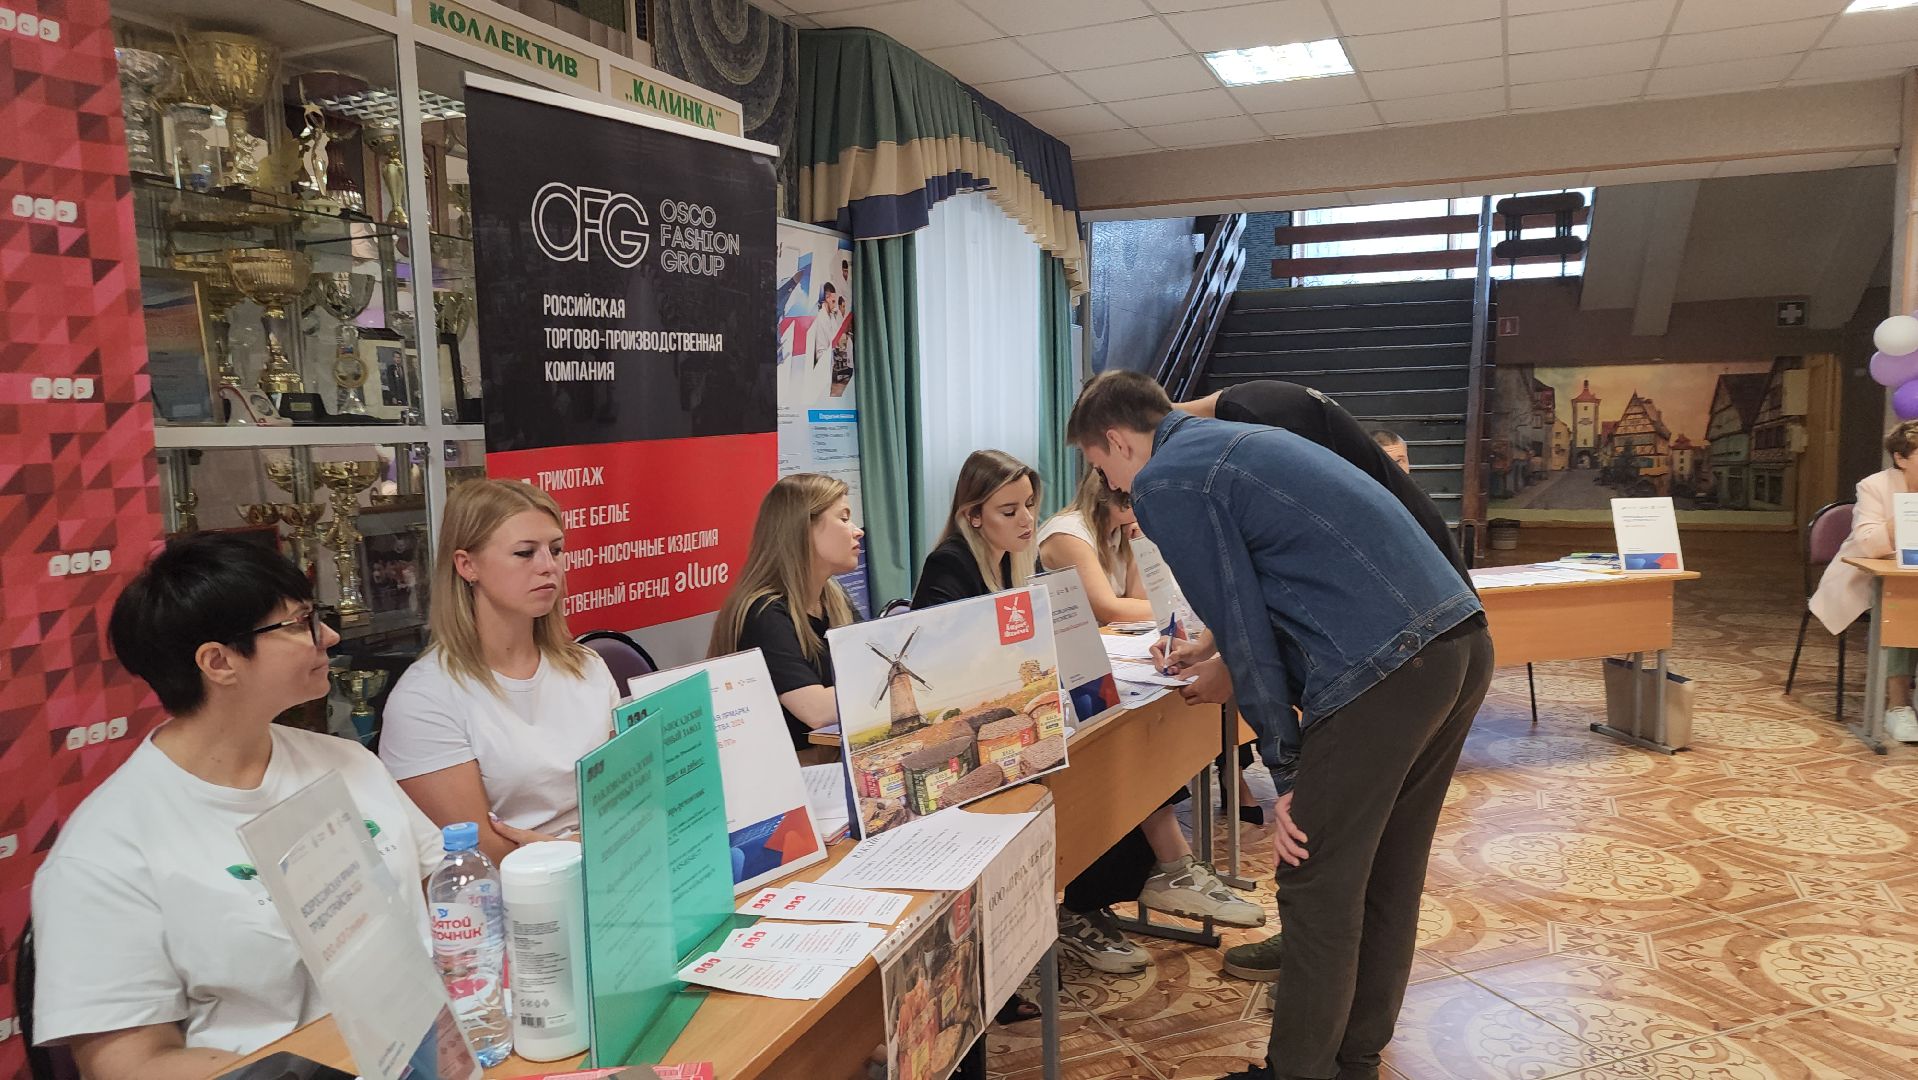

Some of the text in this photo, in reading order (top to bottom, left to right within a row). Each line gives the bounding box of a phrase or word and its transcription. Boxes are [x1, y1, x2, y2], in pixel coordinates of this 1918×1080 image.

[429, 1, 579, 79] КОЛЛЕКТИВ
[531, 182, 650, 269] OFG
[659, 199, 717, 228] OSCO
[660, 224, 740, 256] FASHION
[660, 249, 725, 277] GROUP
[543, 293, 626, 319] РОССИЙСКАЯ
[544, 327, 723, 352] ТОРГОВО-ПРОИЗВОДСТВЕННАЯ
[544, 360, 615, 382] КОМПАНИЯ
[537, 466, 604, 492] ТРИКОТАЖ
[590, 503, 630, 527] БЕЛЬЕ
[667, 528, 719, 553] ИЗДЕЛИЯ
[629, 577, 670, 601] БРЕНД
[674, 562, 729, 593] allure
